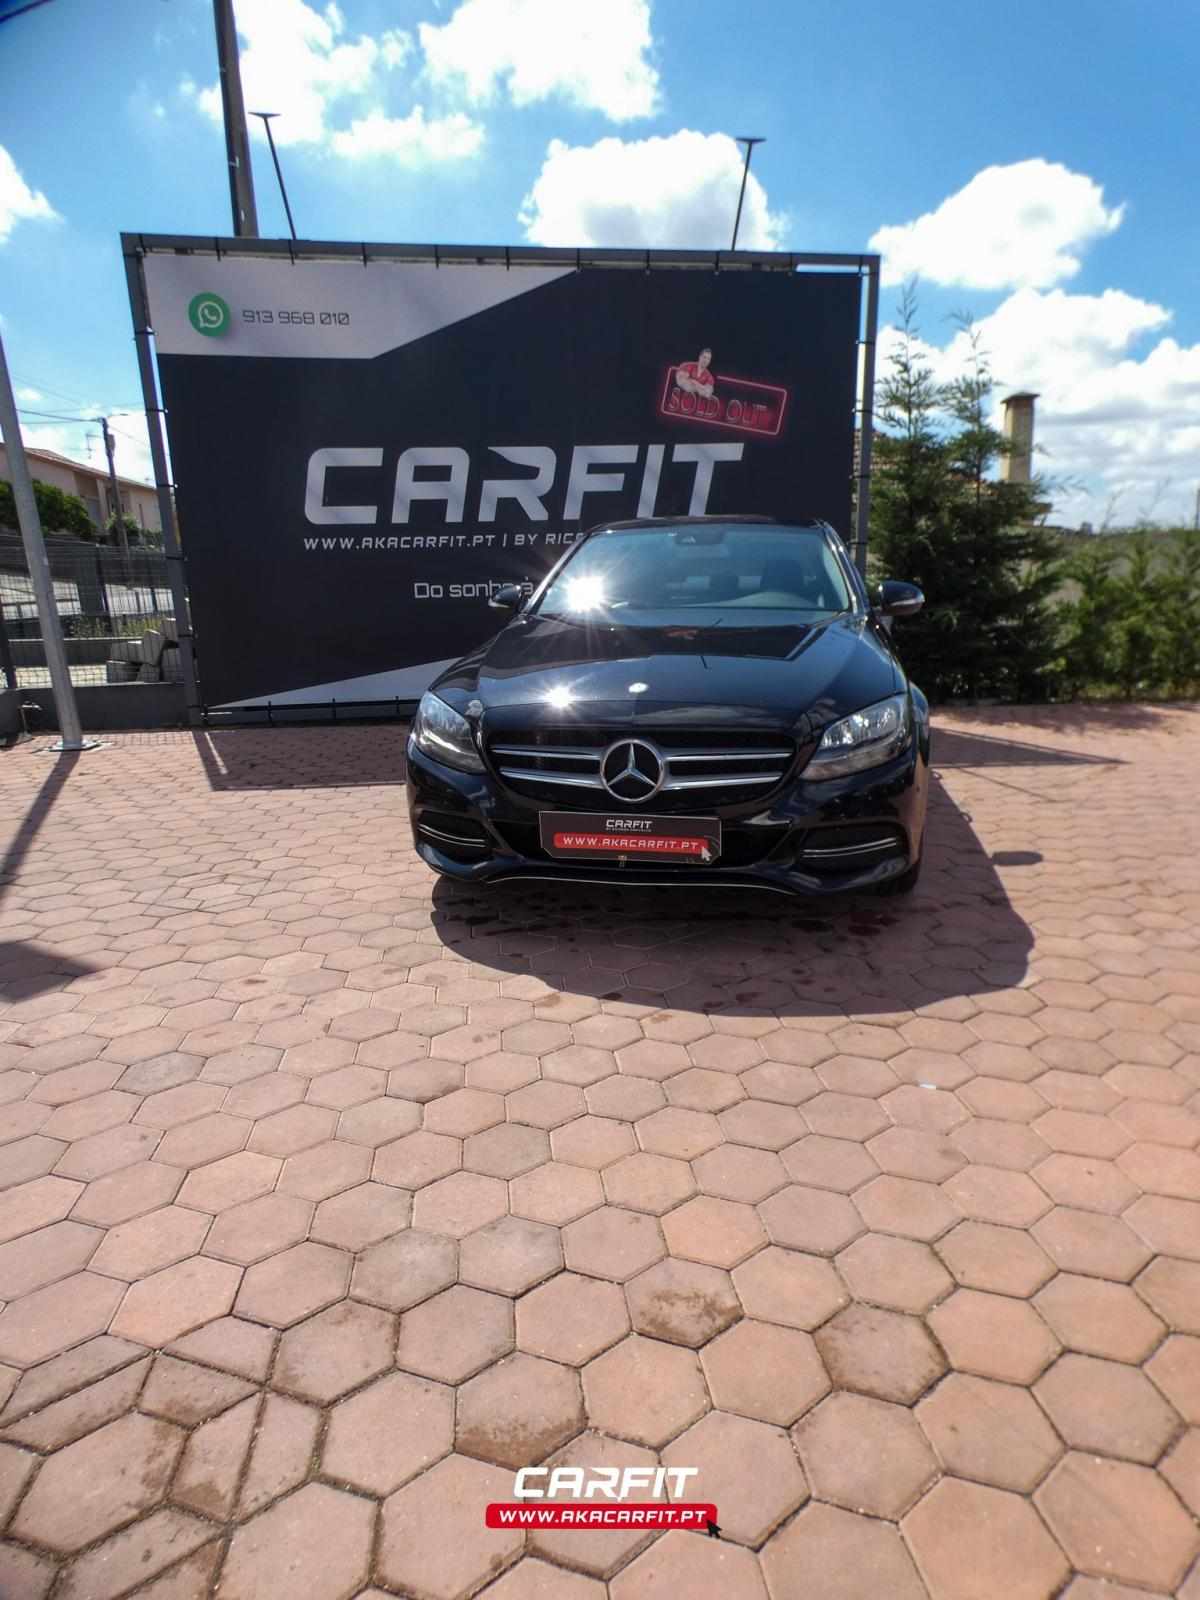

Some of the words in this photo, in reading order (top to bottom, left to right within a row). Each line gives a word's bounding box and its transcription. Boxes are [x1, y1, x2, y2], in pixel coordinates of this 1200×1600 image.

[242, 309, 273, 323] 913
[278, 311, 315, 325] 968
[320, 312, 350, 325] 010
[304, 443, 744, 525] CARFIT
[304, 533, 496, 550] WWW.AKACARFIT.PT
[514, 533, 538, 546] BY
[414, 582, 443, 598] Do
[449, 579, 515, 597] sonh
[606, 819, 653, 829] CARFIT
[563, 836, 698, 850] WWW.AKACARFIT.PT
